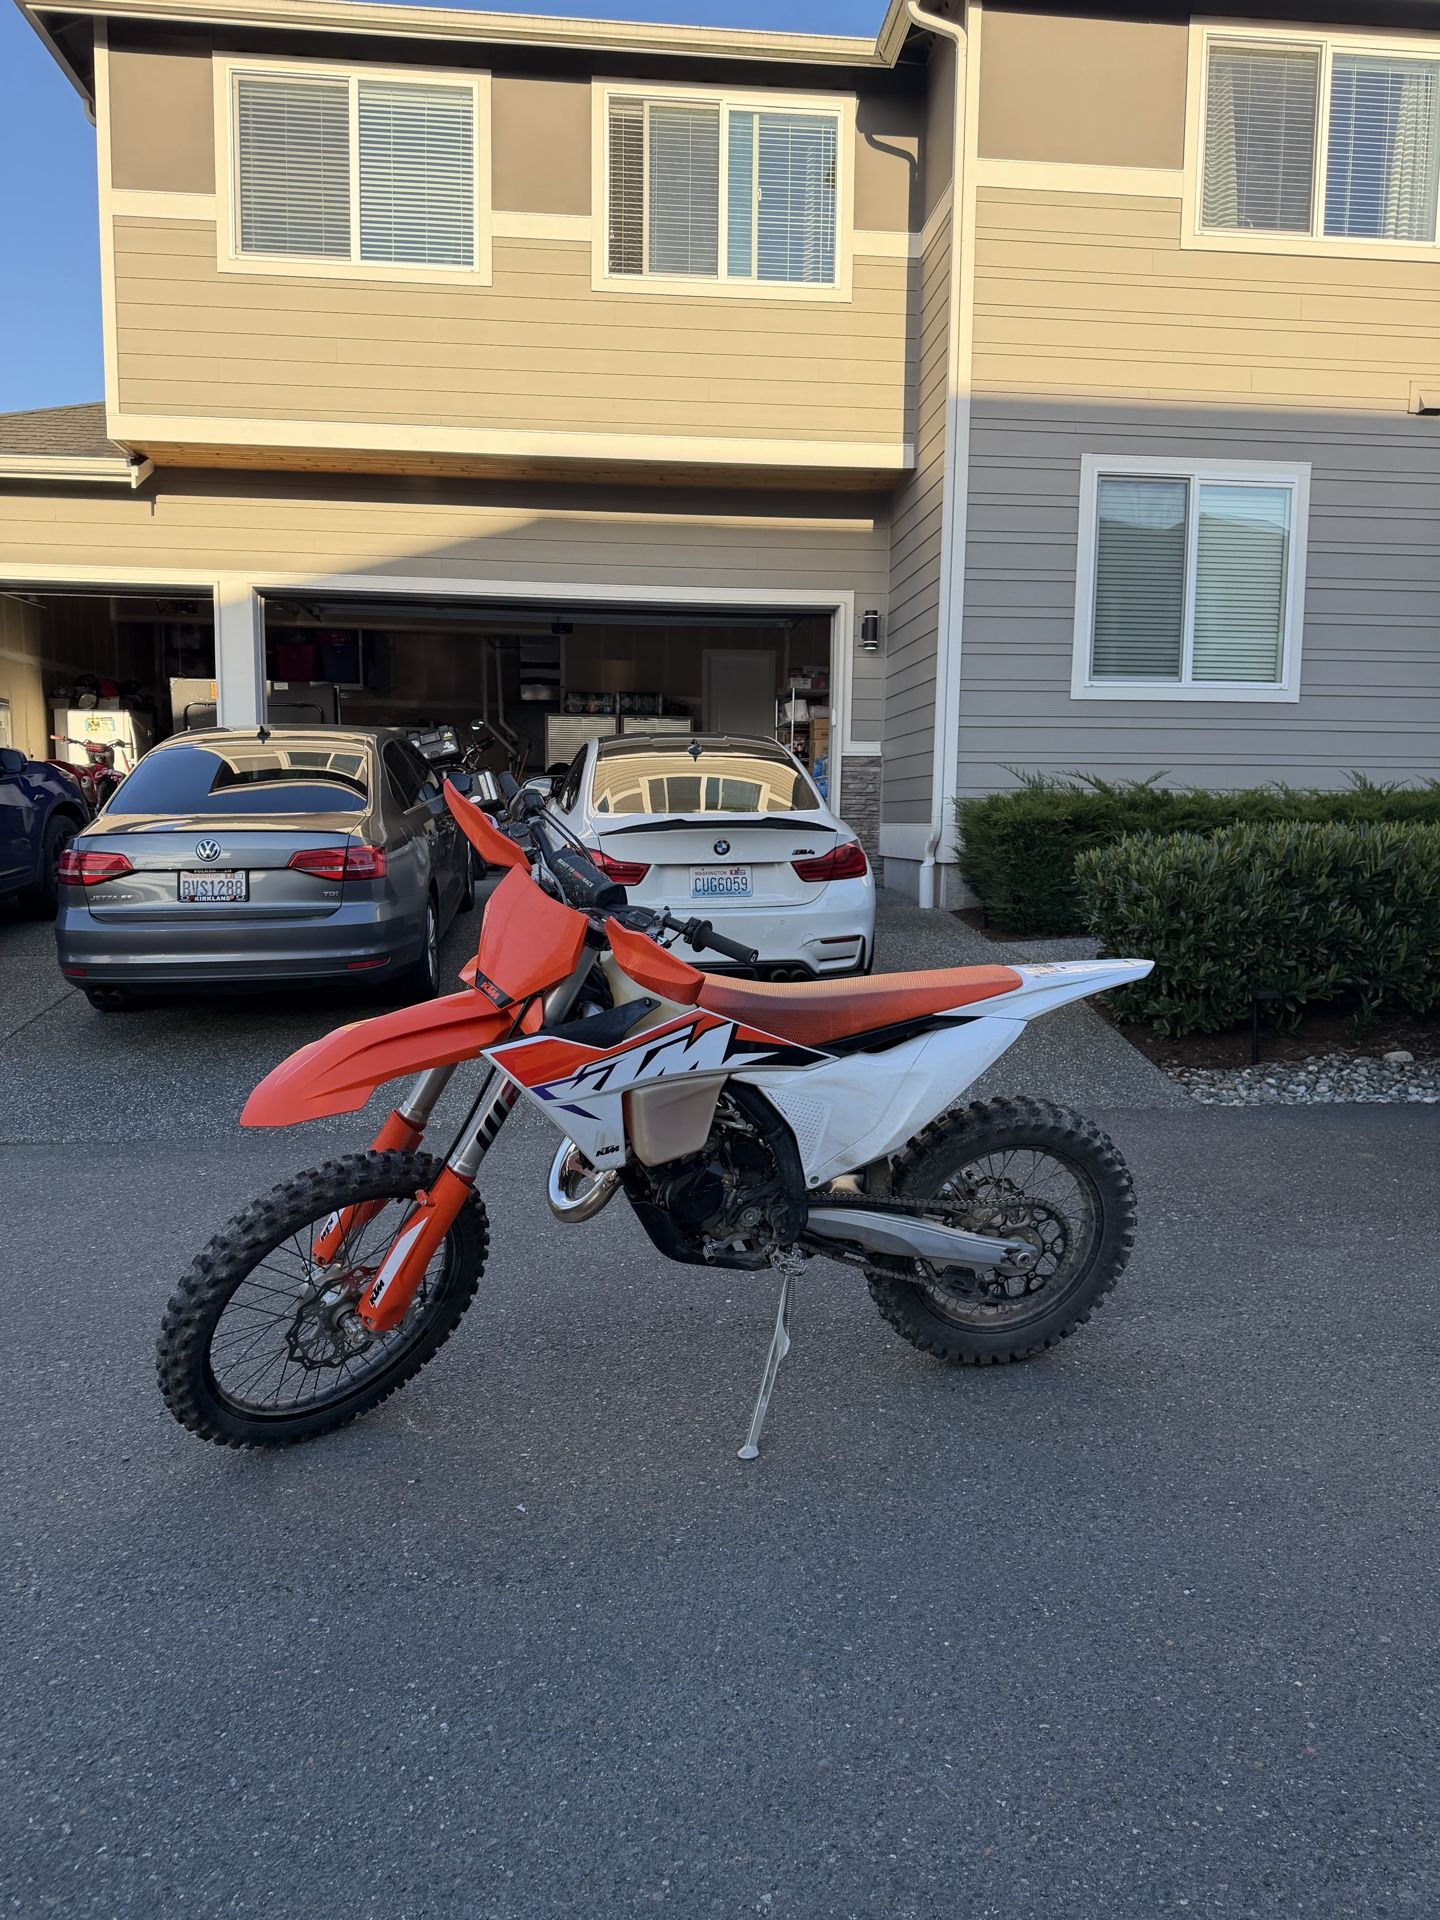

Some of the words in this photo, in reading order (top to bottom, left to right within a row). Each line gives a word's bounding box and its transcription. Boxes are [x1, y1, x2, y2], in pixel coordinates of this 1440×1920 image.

[182, 880, 243, 897] BVS1288
[694, 876, 748, 892] CUG6059
[481, 981, 500, 1000] KTM
[595, 1145, 620, 1157] KTM
[369, 1280, 385, 1305] KTM
